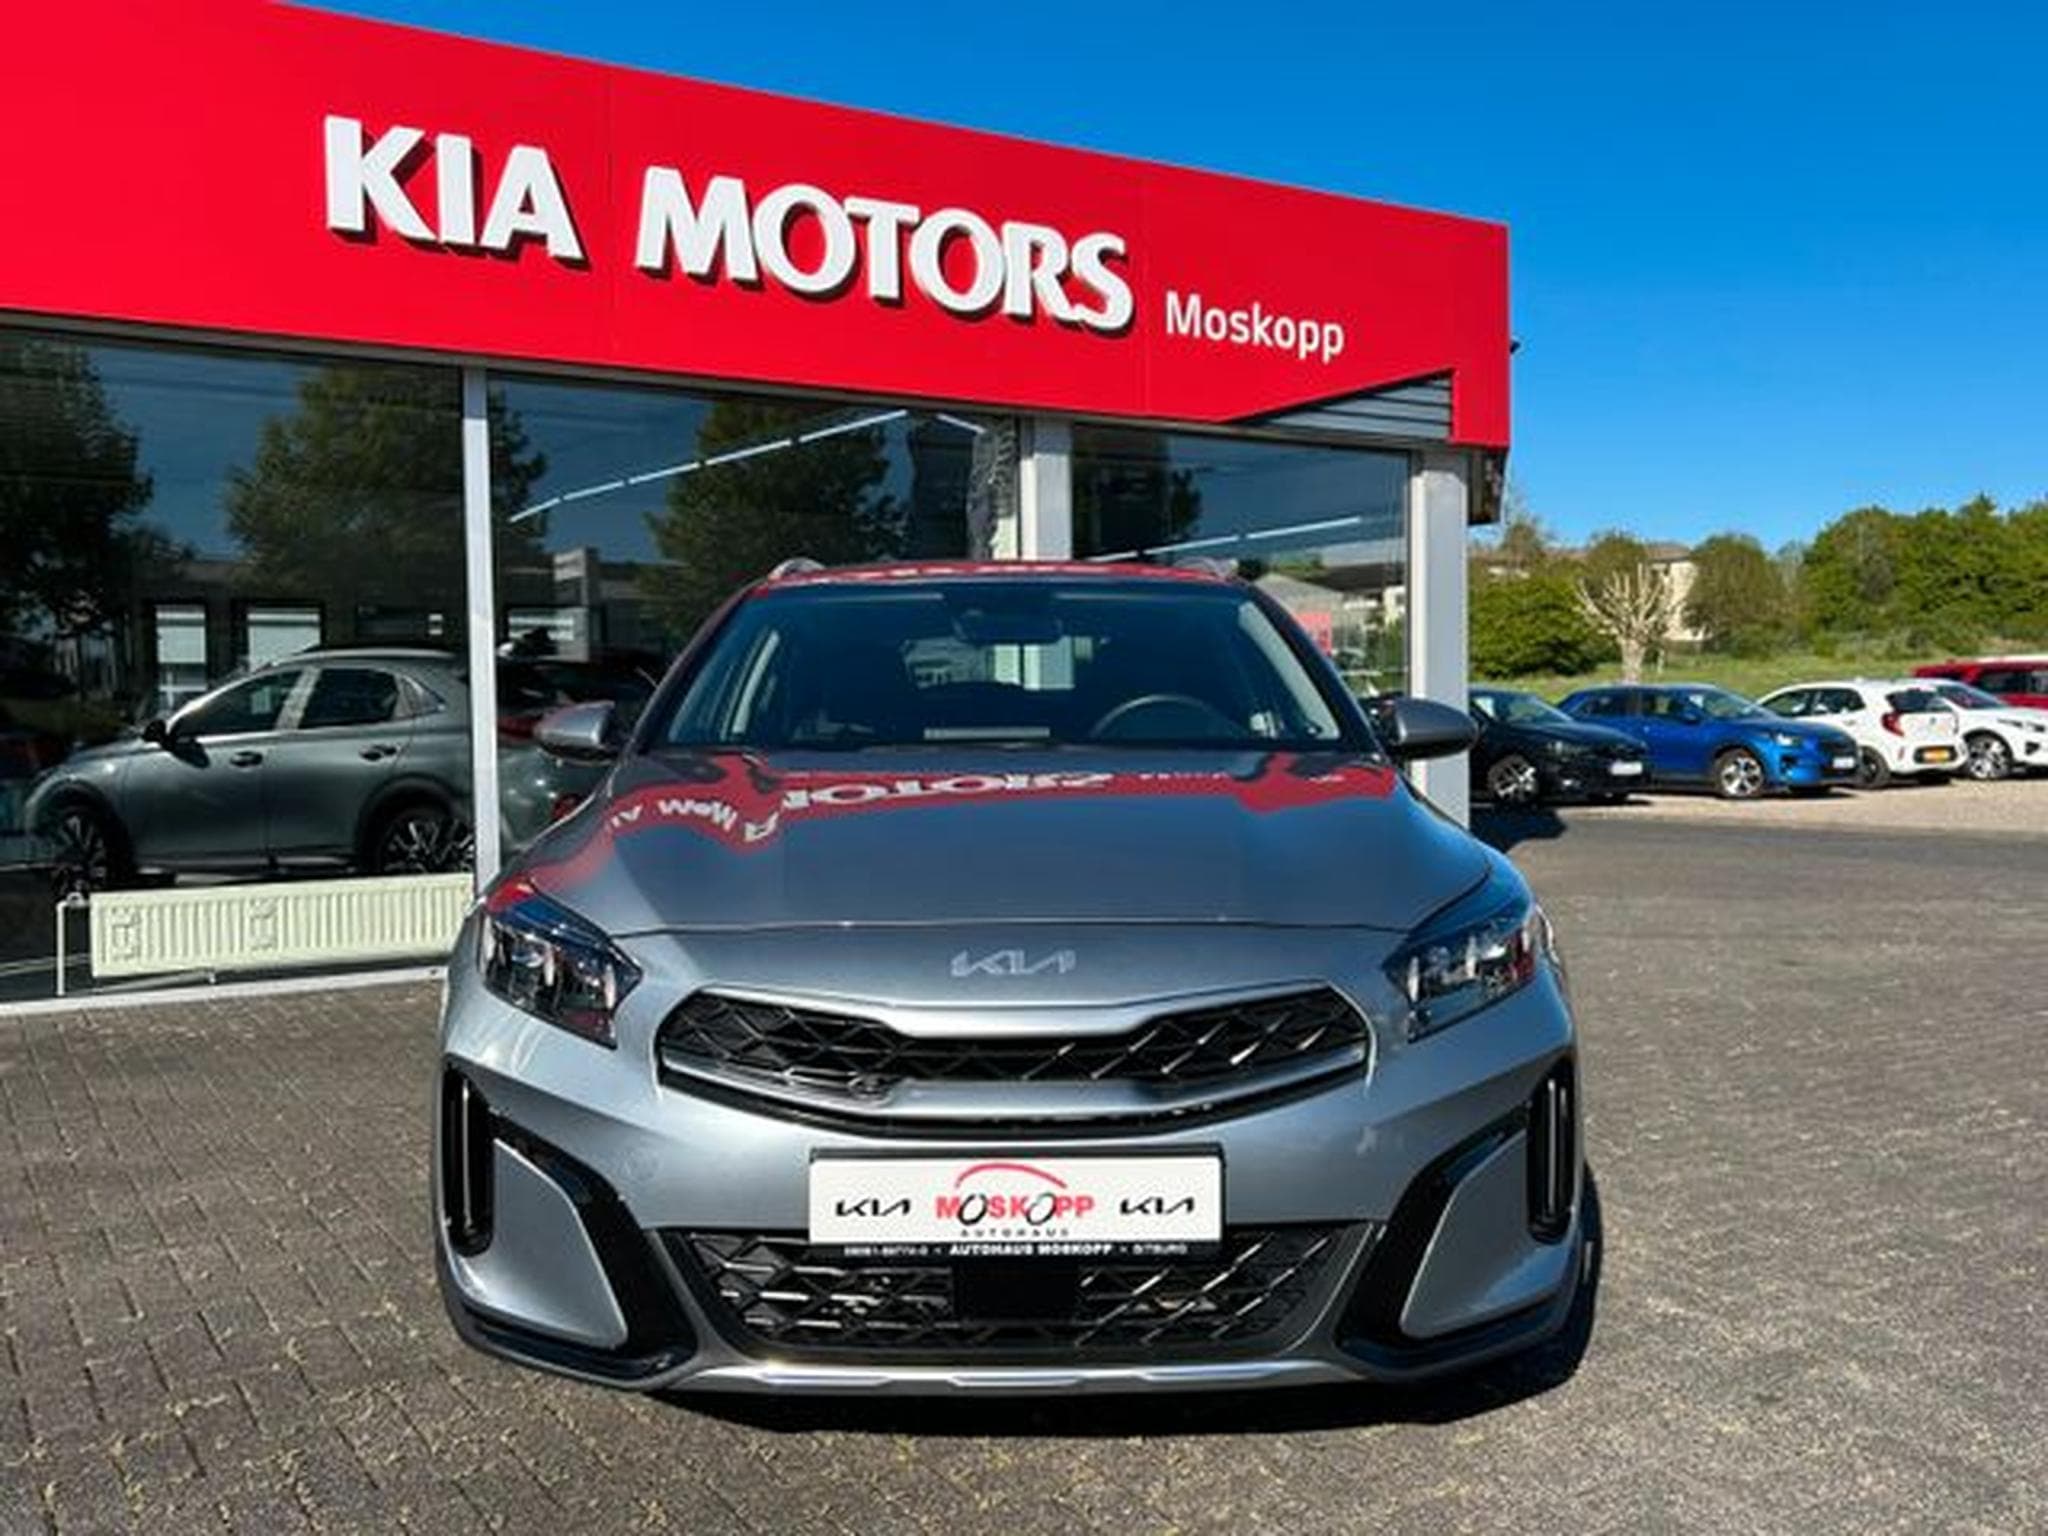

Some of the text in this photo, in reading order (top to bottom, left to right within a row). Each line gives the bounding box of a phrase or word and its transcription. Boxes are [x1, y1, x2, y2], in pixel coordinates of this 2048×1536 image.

[324, 116, 1135, 330] KIA MOTORS
[1165, 291, 1345, 363] Moskopp
[951, 949, 1076, 976] KIA
[836, 1193, 1195, 1226] KIA MOSKOPP KIA
[960, 1228, 1069, 1238] AUTOHAUS
